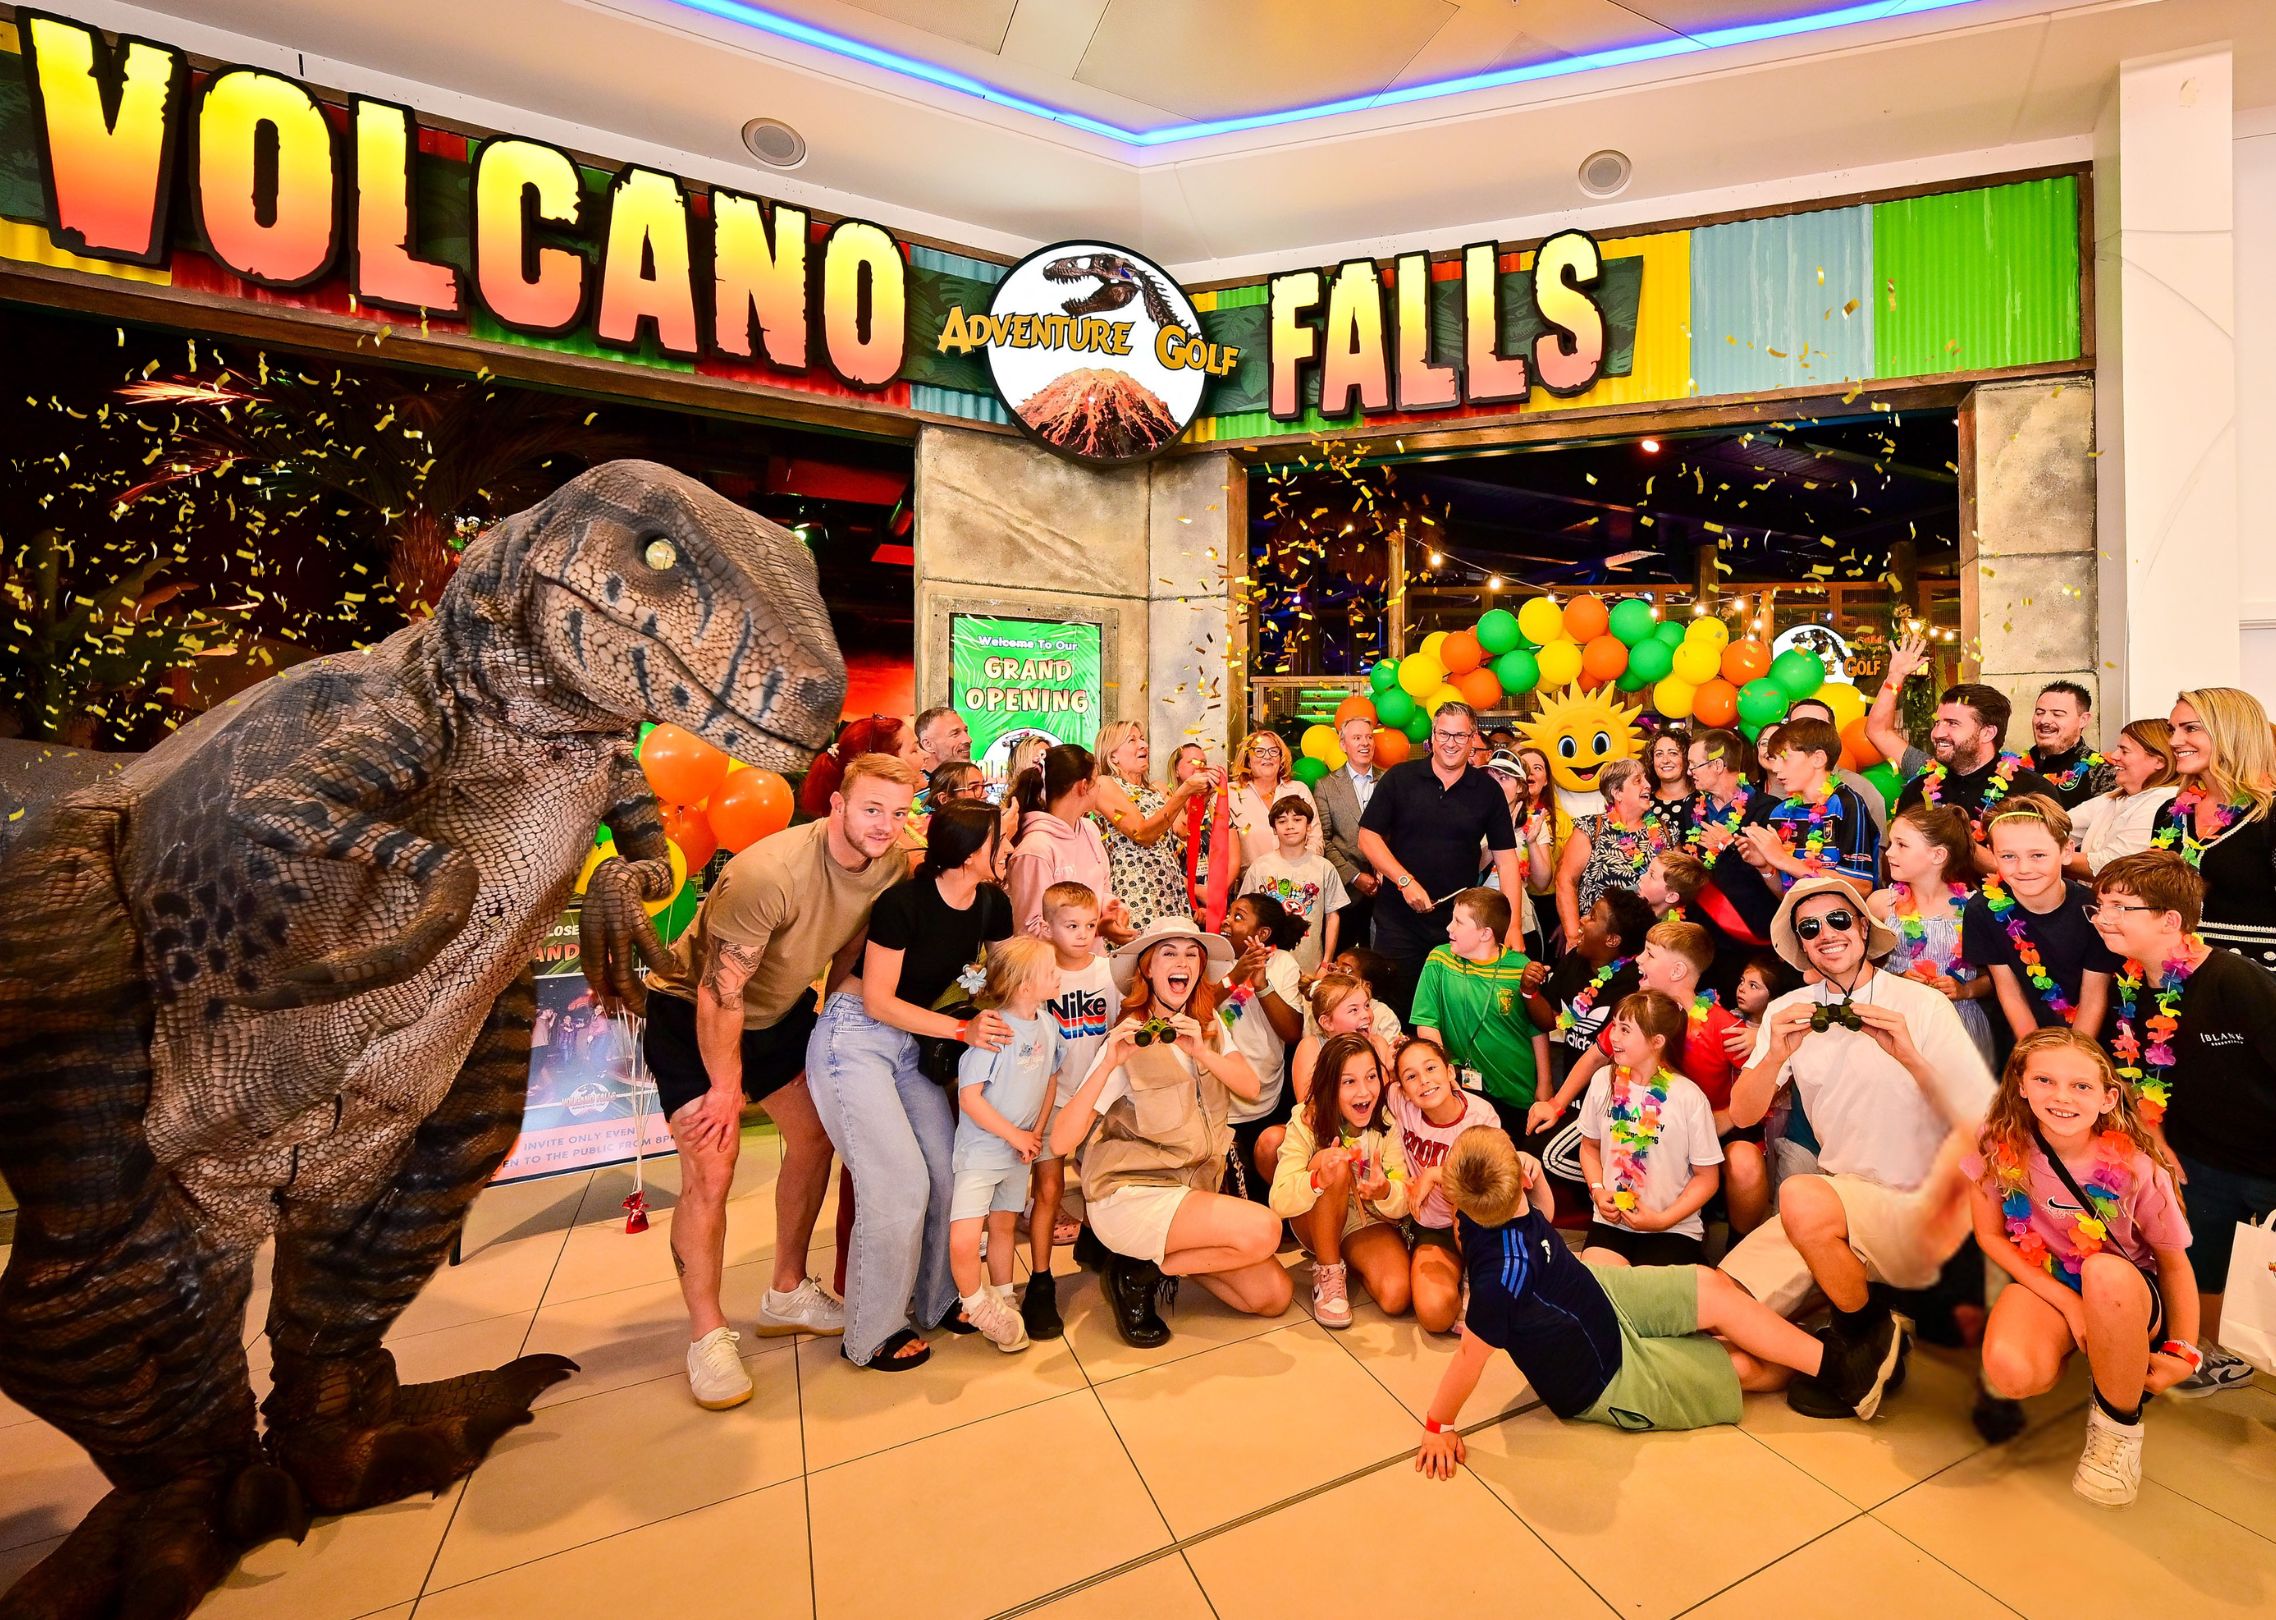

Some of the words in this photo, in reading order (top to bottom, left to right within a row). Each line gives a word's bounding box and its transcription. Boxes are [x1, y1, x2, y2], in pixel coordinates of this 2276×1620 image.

[16, 8, 909, 390] VOLCANO
[1267, 228, 1603, 421] FALLS
[936, 303, 1134, 358] ADVENTURE
[1153, 322, 1241, 379] GOLF
[978, 635, 1034, 649] Welcome
[1038, 639, 1052, 650] To
[1055, 641, 1078, 651] Our
[984, 656, 1072, 682] GRAND
[1843, 656, 1881, 678] GOLF
[965, 687, 1089, 714] OPENING
[1047, 989, 1107, 1020] Nike
[525, 1138, 564, 1151] INVITE
[569, 1132, 601, 1144] ONLY
[525, 1155, 541, 1165] TO
[546, 1151, 569, 1161] THE
[572, 1143, 614, 1157] PUBLIC
